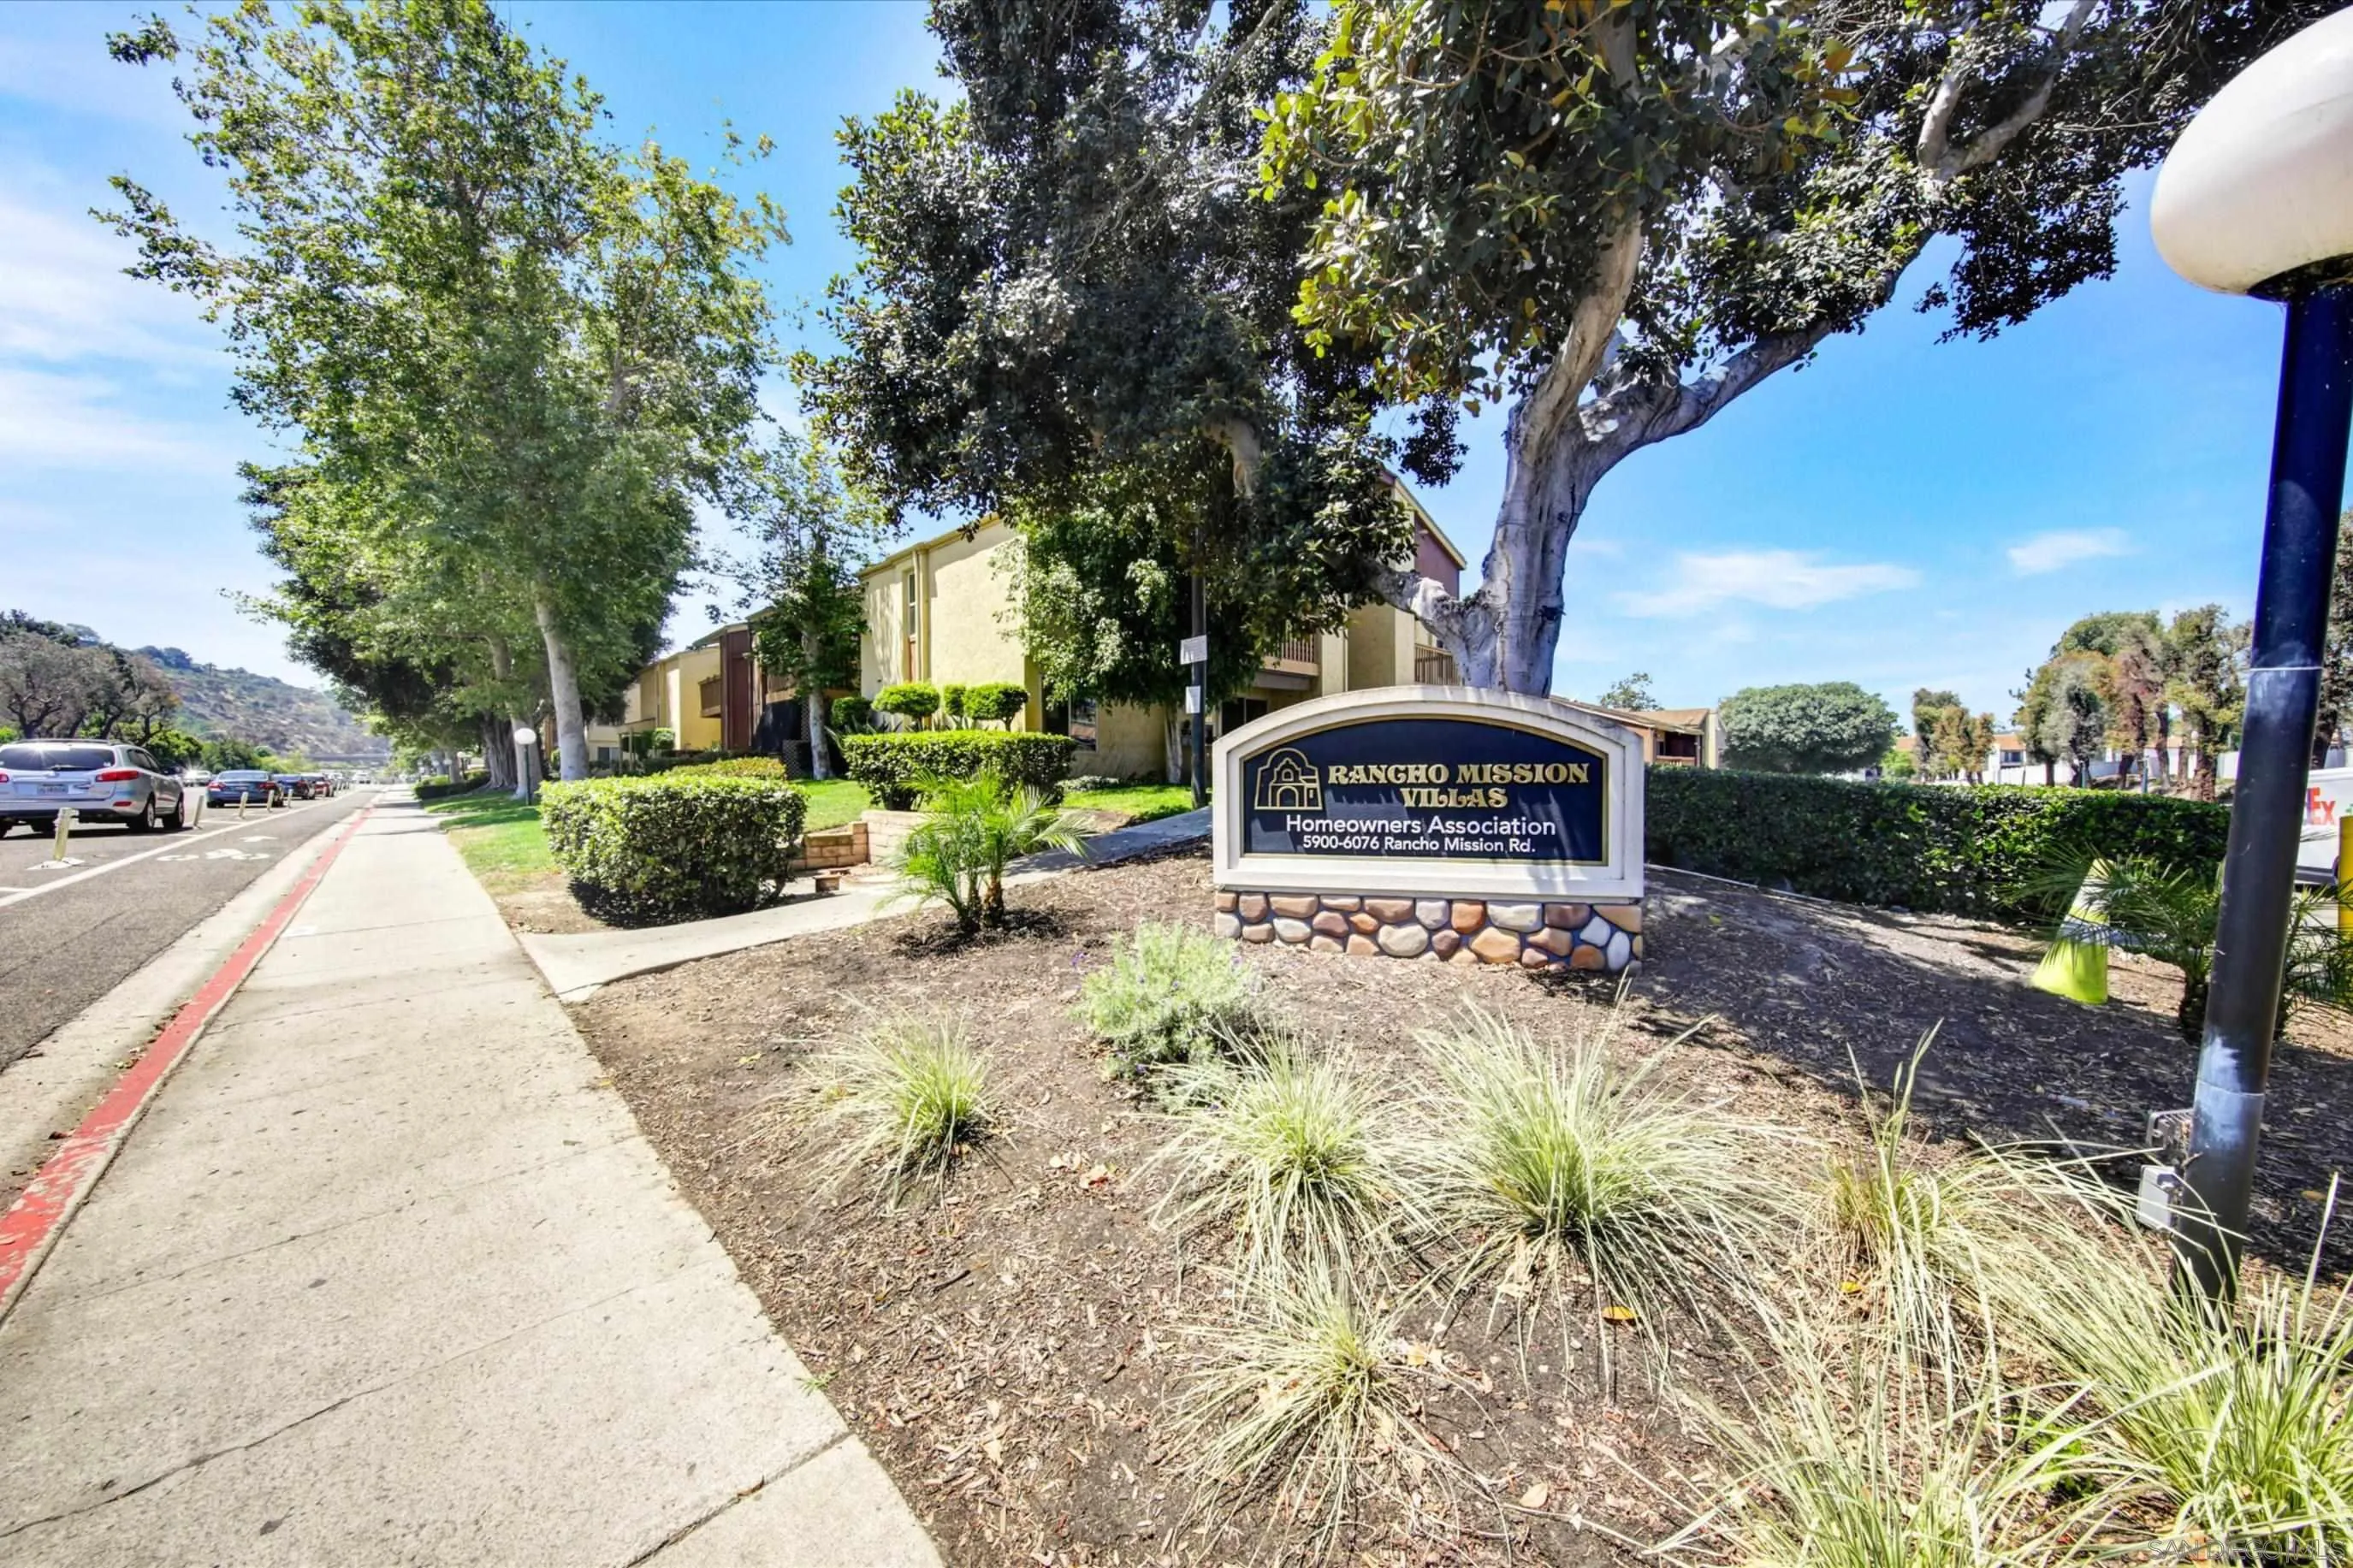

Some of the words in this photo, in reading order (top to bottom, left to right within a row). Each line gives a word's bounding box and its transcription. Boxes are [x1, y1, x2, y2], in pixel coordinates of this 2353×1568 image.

[1328, 764, 1449, 784] RANCHO
[1455, 763, 1590, 784] MISSION
[1400, 788, 1508, 808] VILLAS
[1286, 814, 1422, 834] Homeowners
[1428, 815, 1556, 836] Association
[1302, 835, 1380, 849] 5900-6076
[1384, 836, 1439, 850] Rancho
[1444, 837, 1503, 852] Mission
[1508, 837, 1536, 853] Rd.
